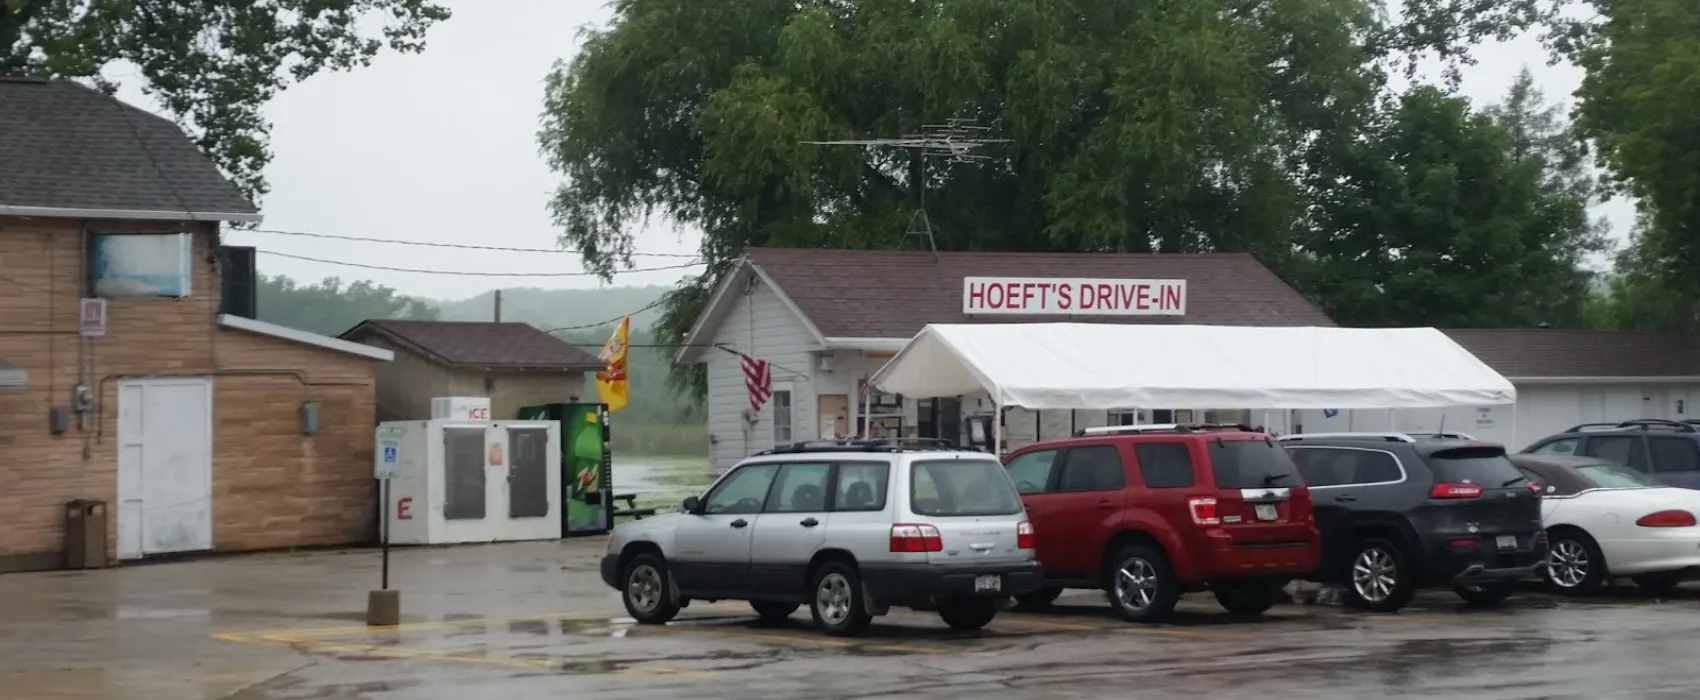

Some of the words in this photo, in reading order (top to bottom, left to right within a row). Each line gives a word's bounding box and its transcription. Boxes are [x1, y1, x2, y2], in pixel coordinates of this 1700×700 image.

[969, 282, 1072, 310] HOEFT'S
[1079, 284, 1181, 310] DRIVE-IN
[468, 408, 488, 419] ICE
